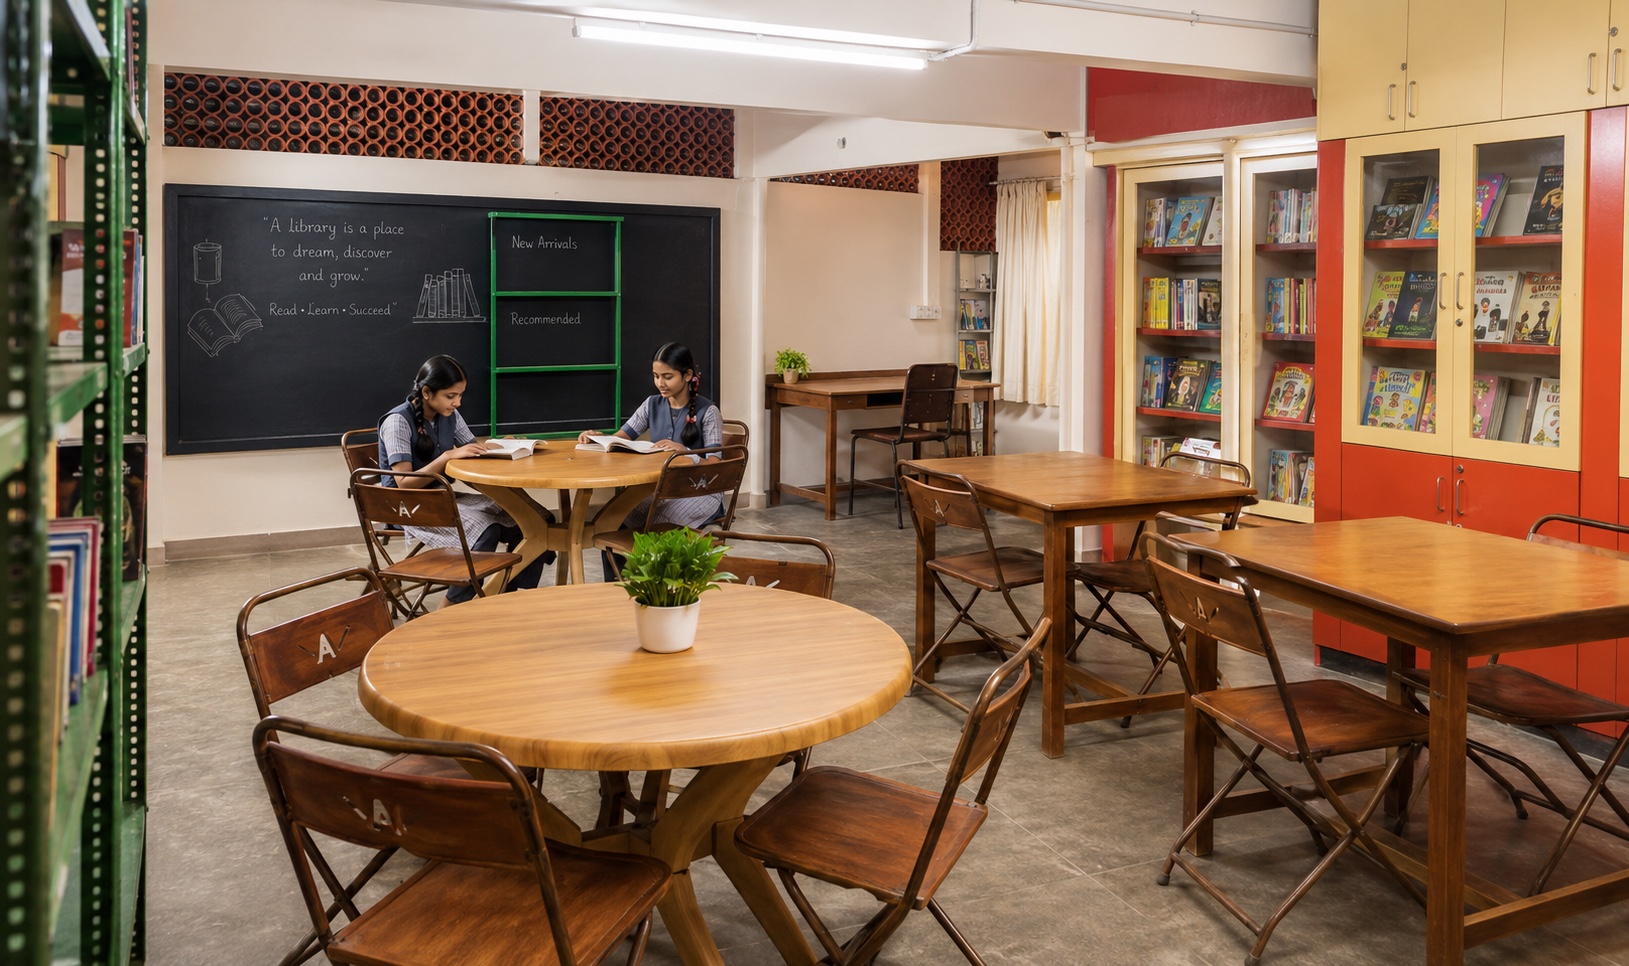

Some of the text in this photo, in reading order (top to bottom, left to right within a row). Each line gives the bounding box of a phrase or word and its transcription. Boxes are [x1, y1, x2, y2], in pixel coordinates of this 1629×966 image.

[343, 222, 354, 234] is
[359, 224, 367, 234] a
[373, 221, 404, 240] place
[511, 235, 578, 250] New Arrivals
[271, 243, 392, 261] to dream, discover
[299, 268, 323, 281] and
[269, 302, 297, 316] Read
[307, 302, 339, 316] Learn
[510, 311, 581, 325] Recommended
[317, 633, 337, 664] A
